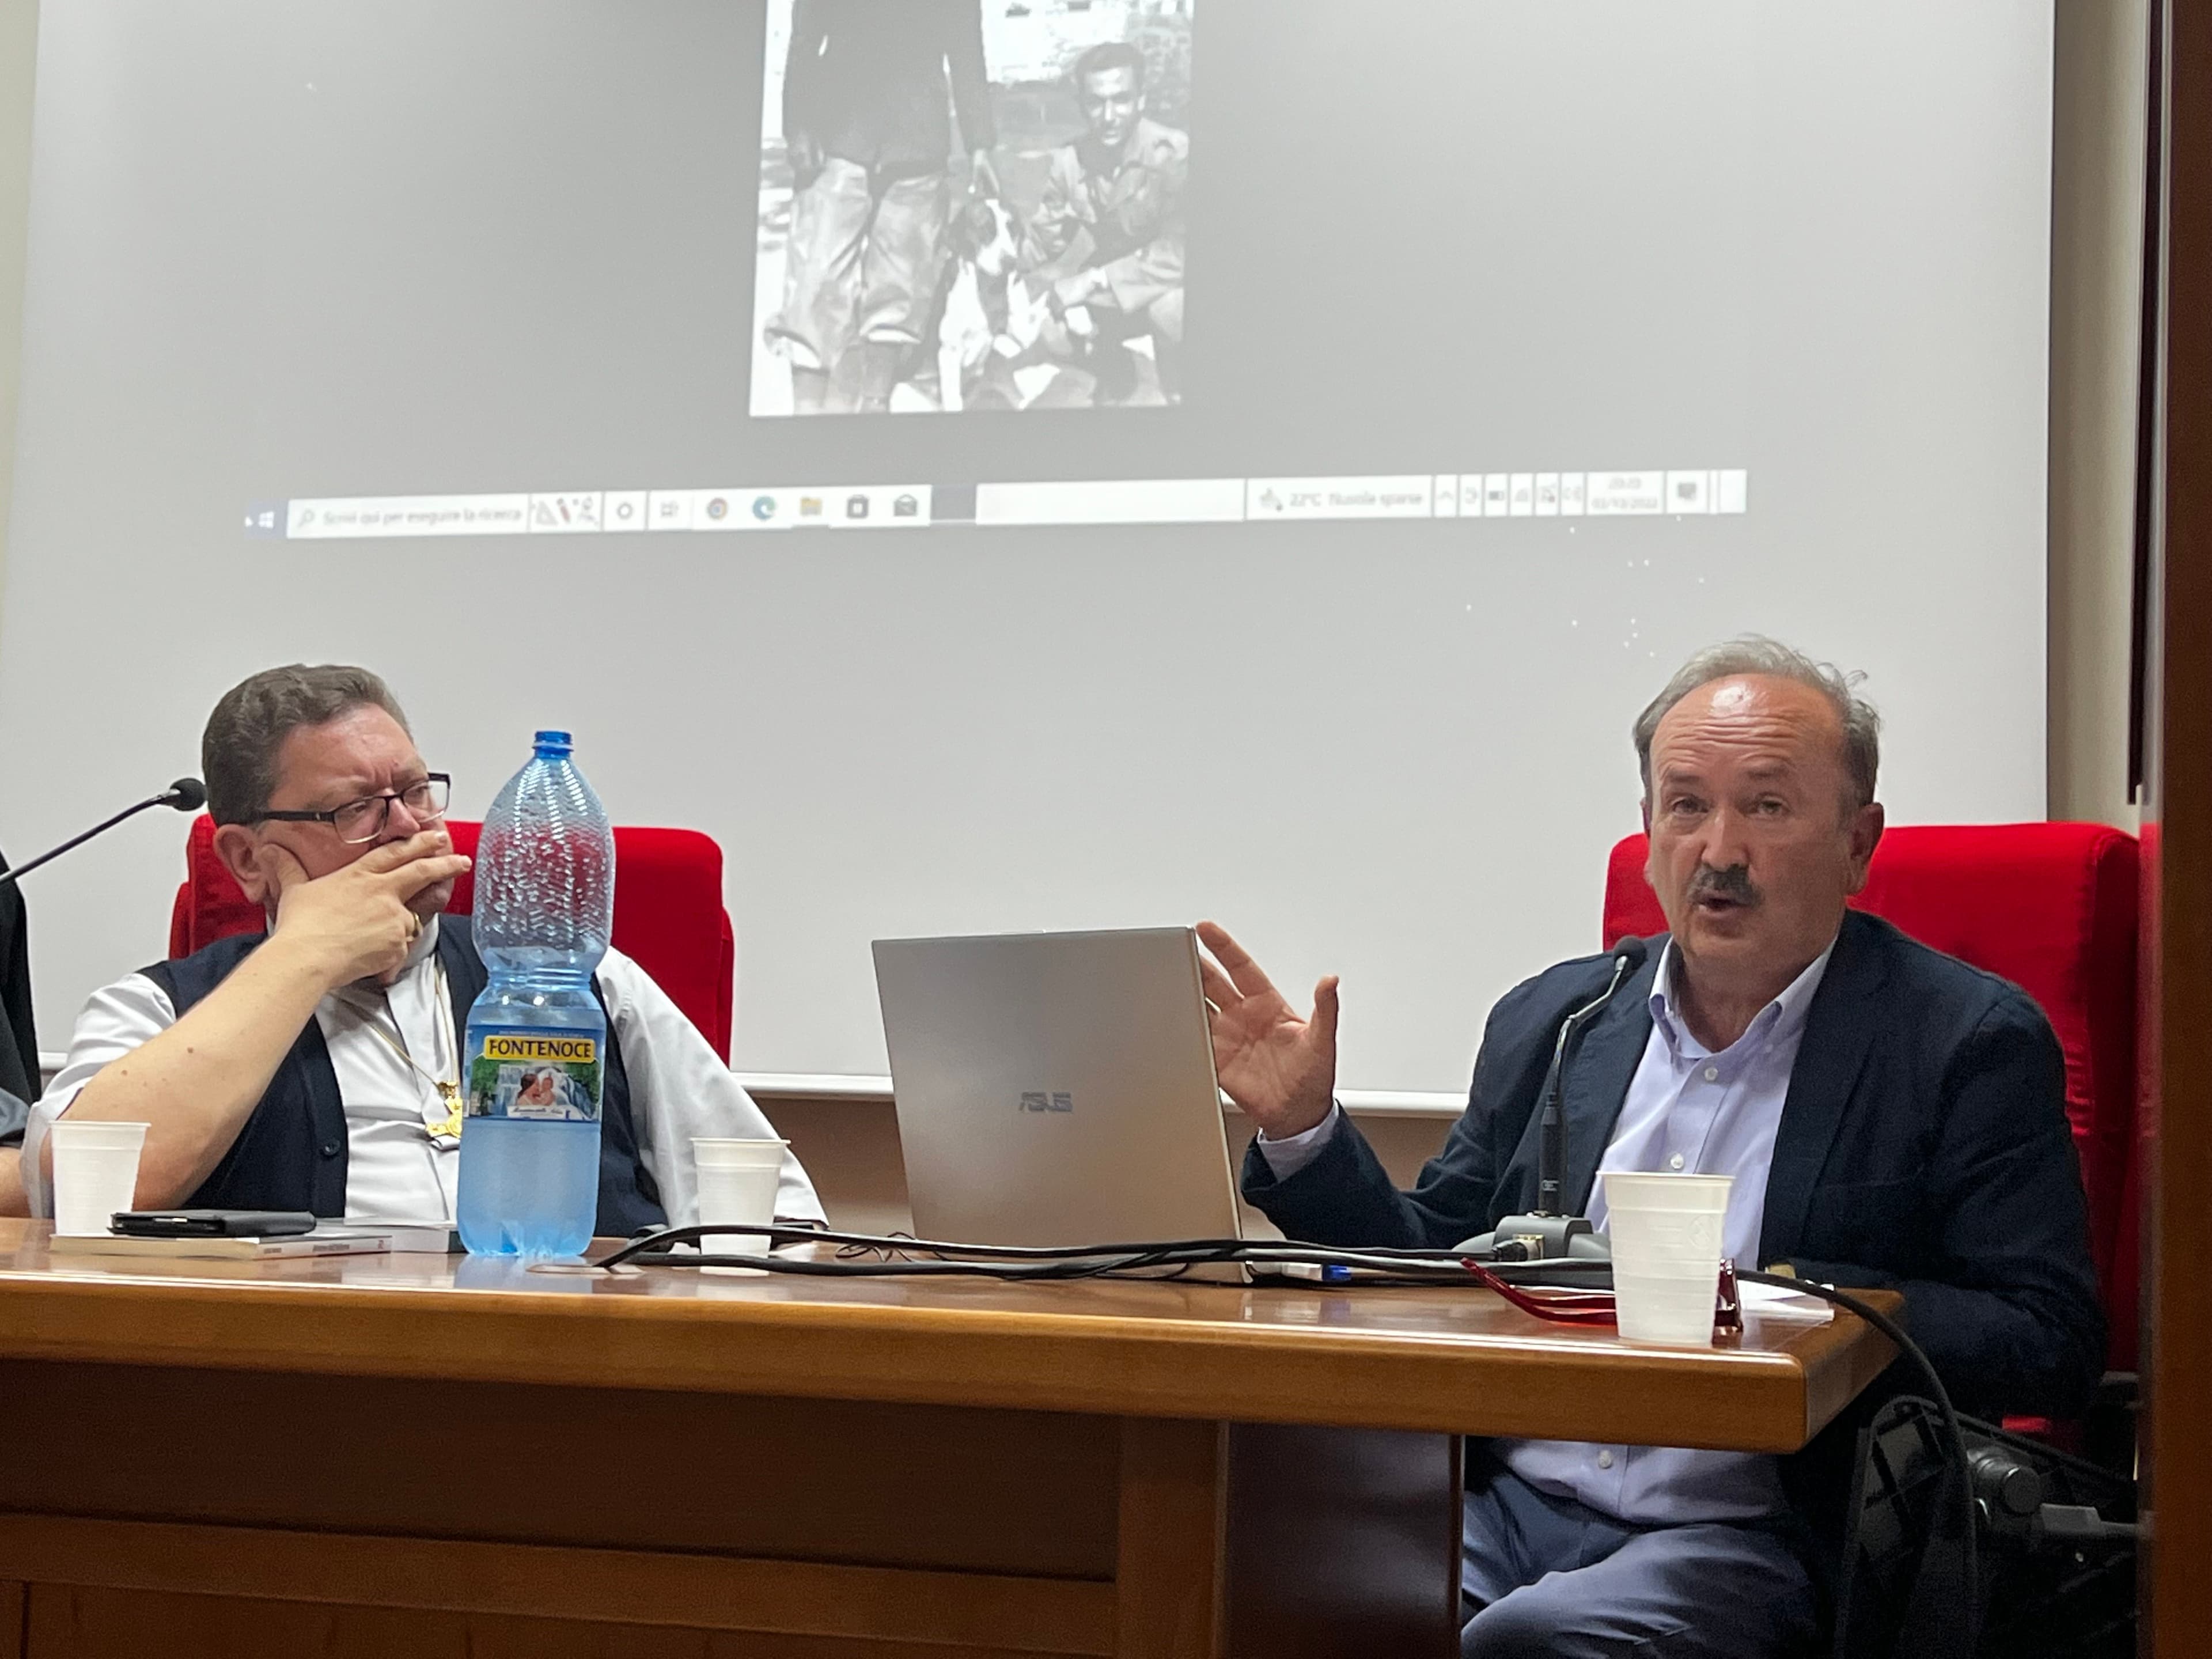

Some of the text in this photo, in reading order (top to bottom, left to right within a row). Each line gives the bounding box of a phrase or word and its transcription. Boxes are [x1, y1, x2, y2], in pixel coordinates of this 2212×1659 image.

[383, 512, 404, 527] per
[463, 507, 475, 522] la
[489, 1039, 592, 1058] FONTENOCE
[1018, 1092, 1073, 1112] ASUS
